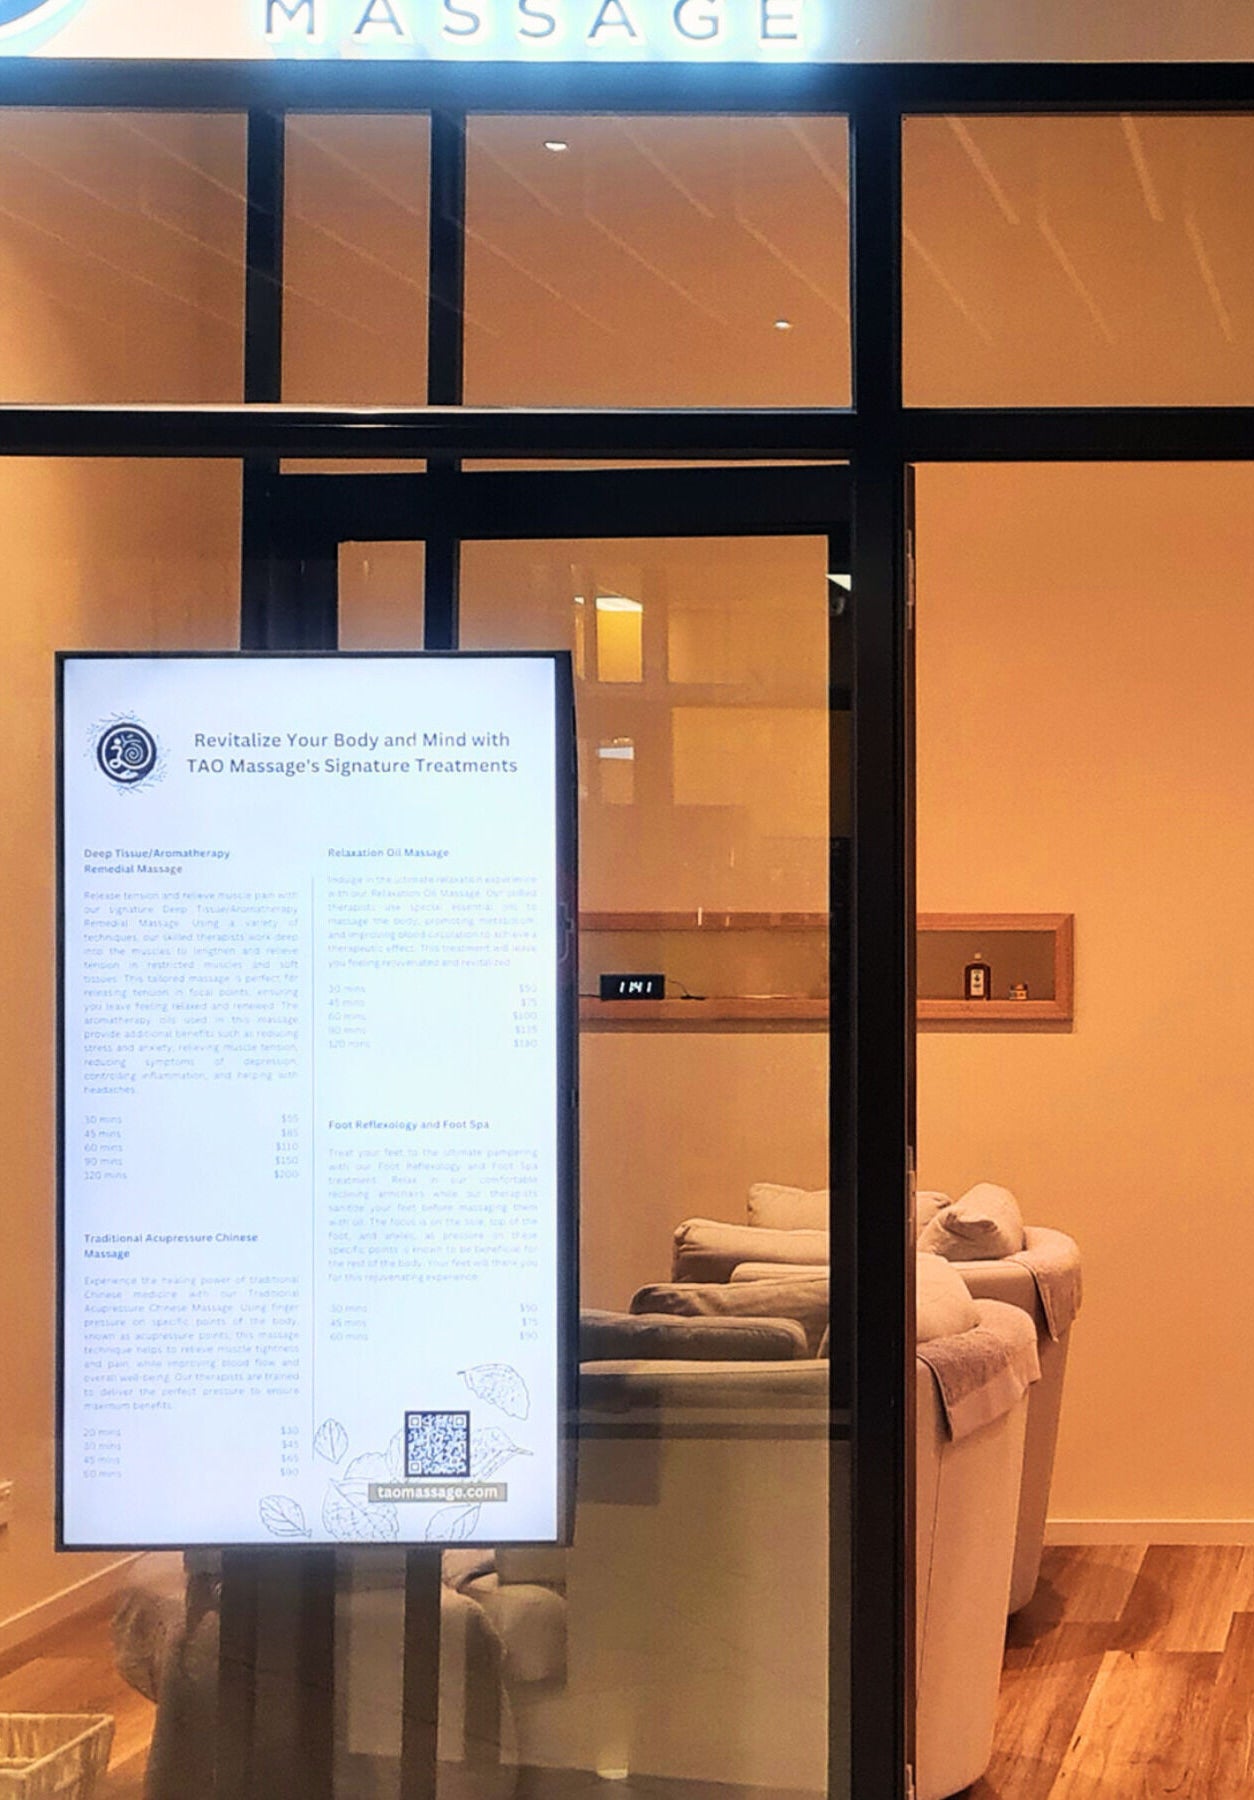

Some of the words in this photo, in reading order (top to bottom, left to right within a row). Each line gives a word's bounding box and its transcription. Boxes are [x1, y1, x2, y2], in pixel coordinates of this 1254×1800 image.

[263, 0, 800, 40] MASSAGE
[195, 733, 281, 747] Revitalize
[287, 733, 328, 747] Your
[334, 733, 379, 750] Body
[384, 733, 416, 747] and
[423, 732, 466, 747] Mind
[472, 732, 509, 746] with
[187, 759, 224, 773] TAO
[230, 759, 320, 776] Massage's
[325, 759, 410, 776] Signature
[415, 759, 518, 772] Treatments
[84, 849, 112, 859] Deep
[115, 849, 230, 858] Tissue/Aromatherapy
[328, 848, 384, 857] Relaxation
[386, 848, 402, 857] Oil
[404, 848, 449, 859] Massage
[84, 865, 134, 874] Remedial
[137, 865, 182, 875] Massage
[329, 1120, 353, 1130] Foot
[355, 1120, 417, 1131] Reflexology
[420, 1121, 440, 1129] and
[443, 1120, 466, 1129] Foot
[470, 1120, 489, 1130] Spa
[84, 1234, 142, 1243] Traditional
[145, 1235, 213, 1243] Acupressure
[215, 1233, 258, 1242] Chinese
[84, 1250, 130, 1260] Massage
[377, 1485, 498, 1502] taomassage.com
